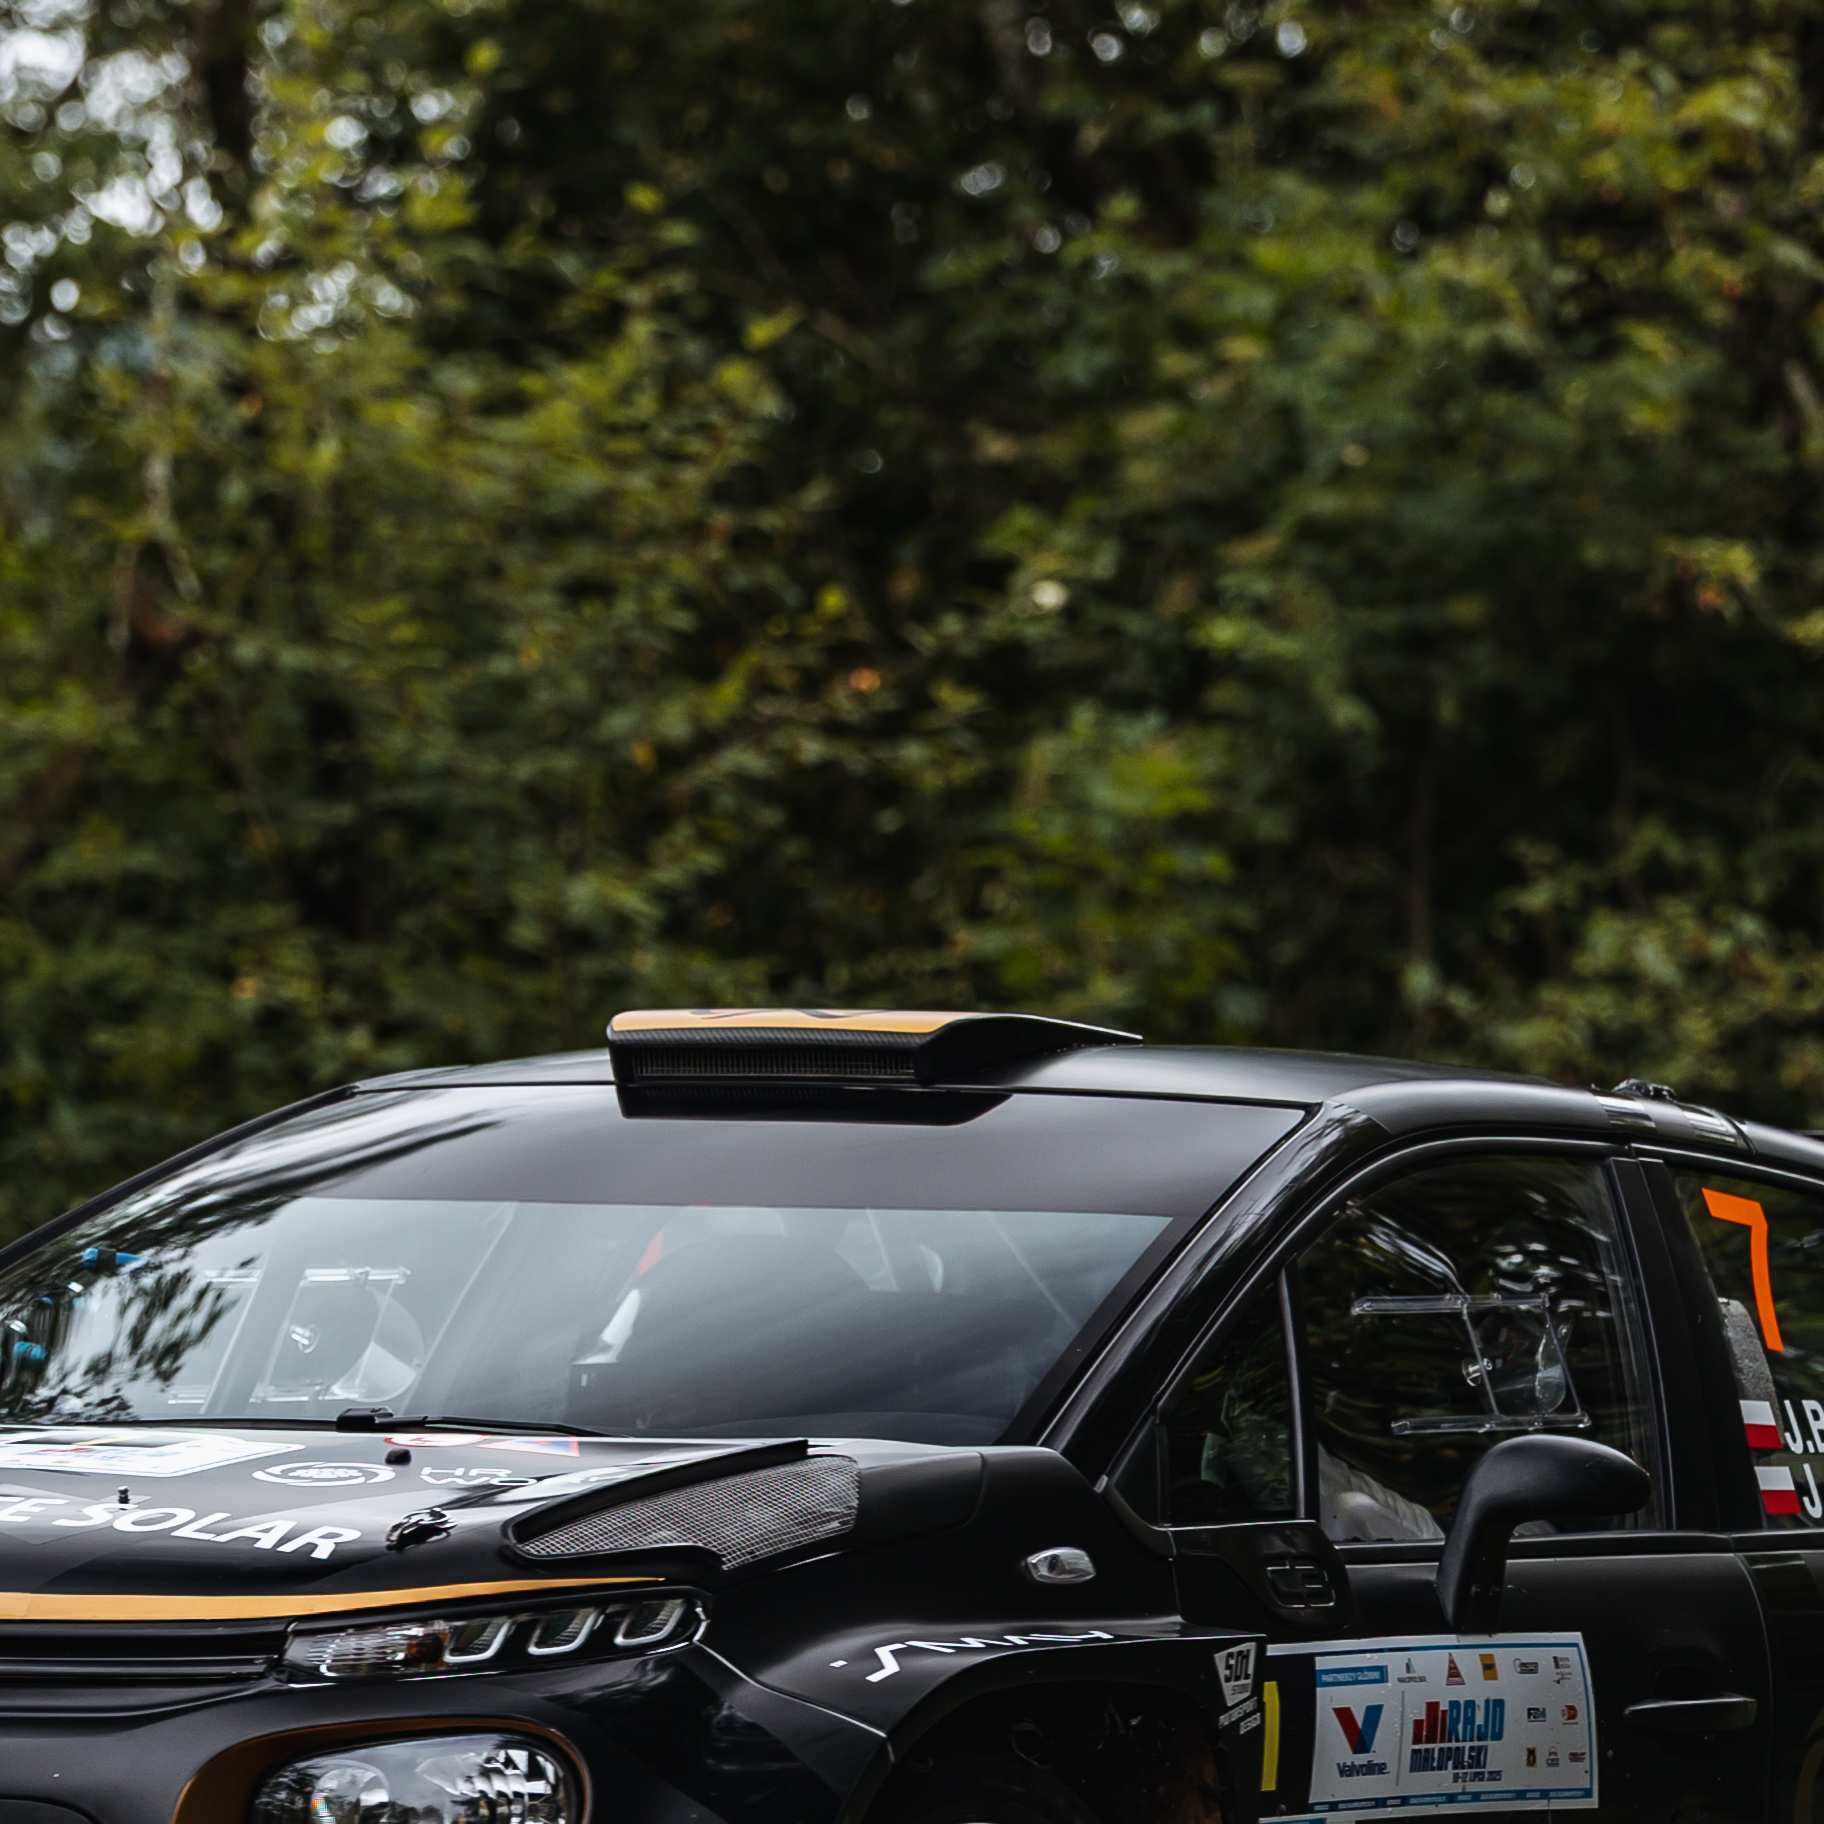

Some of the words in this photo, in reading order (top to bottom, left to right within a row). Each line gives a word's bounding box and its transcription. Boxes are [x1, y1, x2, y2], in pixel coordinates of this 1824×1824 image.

[1702, 1188, 1785, 1353] 7
[52, 1501, 363, 1560] SOLAR
[1447, 1698, 1506, 1744] RAJD
